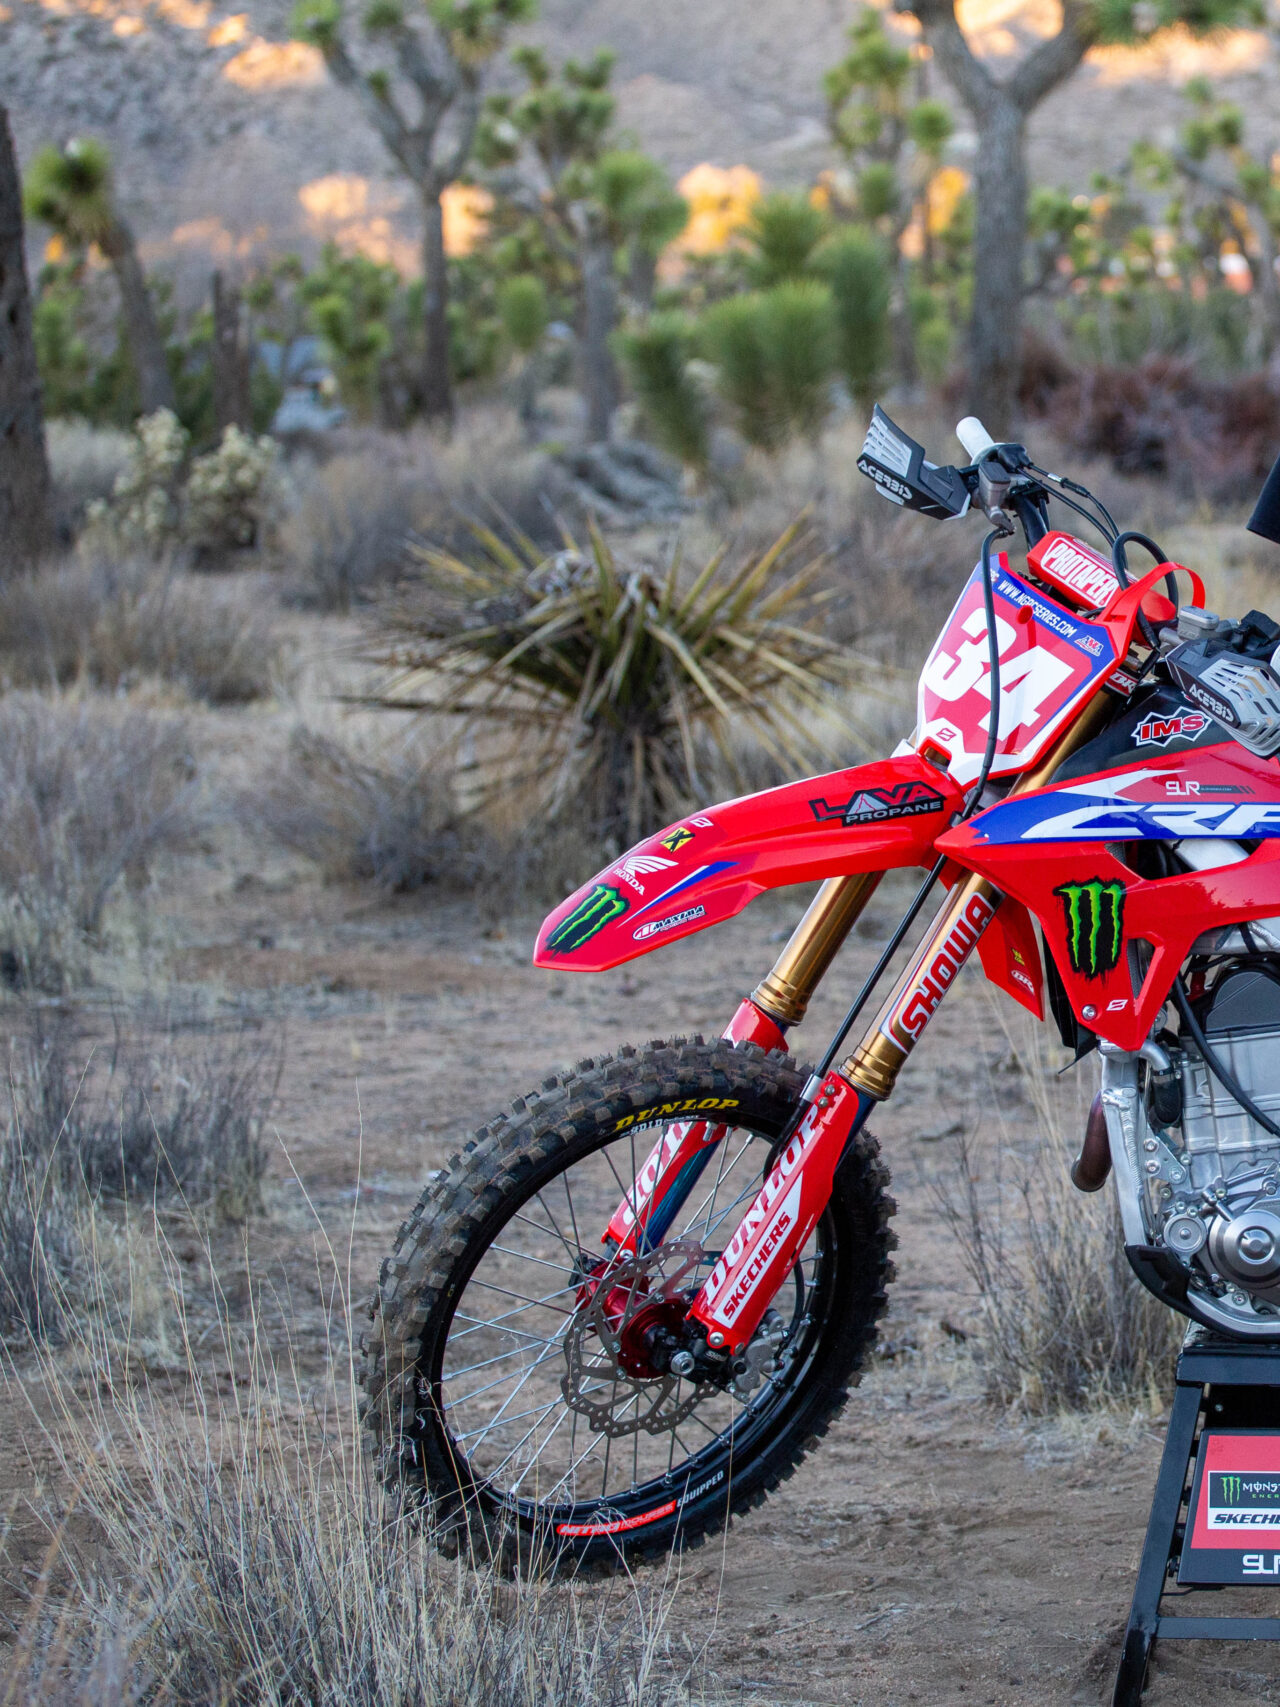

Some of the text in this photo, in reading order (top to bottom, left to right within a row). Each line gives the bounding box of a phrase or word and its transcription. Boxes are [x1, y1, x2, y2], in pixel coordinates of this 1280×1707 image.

[1048, 542, 1120, 603] PROTAPER
[923, 606, 1076, 743] 34
[1140, 714, 1205, 741] IMS
[813, 783, 945, 819] LAVA
[845, 800, 942, 824] PROPANE
[1165, 781, 1201, 796] SLR
[612, 867, 646, 896] HONDA
[900, 892, 994, 1041] SHOWA
[614, 1098, 739, 1132] DUNLOP
[703, 1103, 821, 1305] DUNLOP
[723, 1211, 791, 1320] SKECHERS
[560, 1521, 620, 1535] NITRO
[676, 1470, 725, 1508] EQUIPPED
